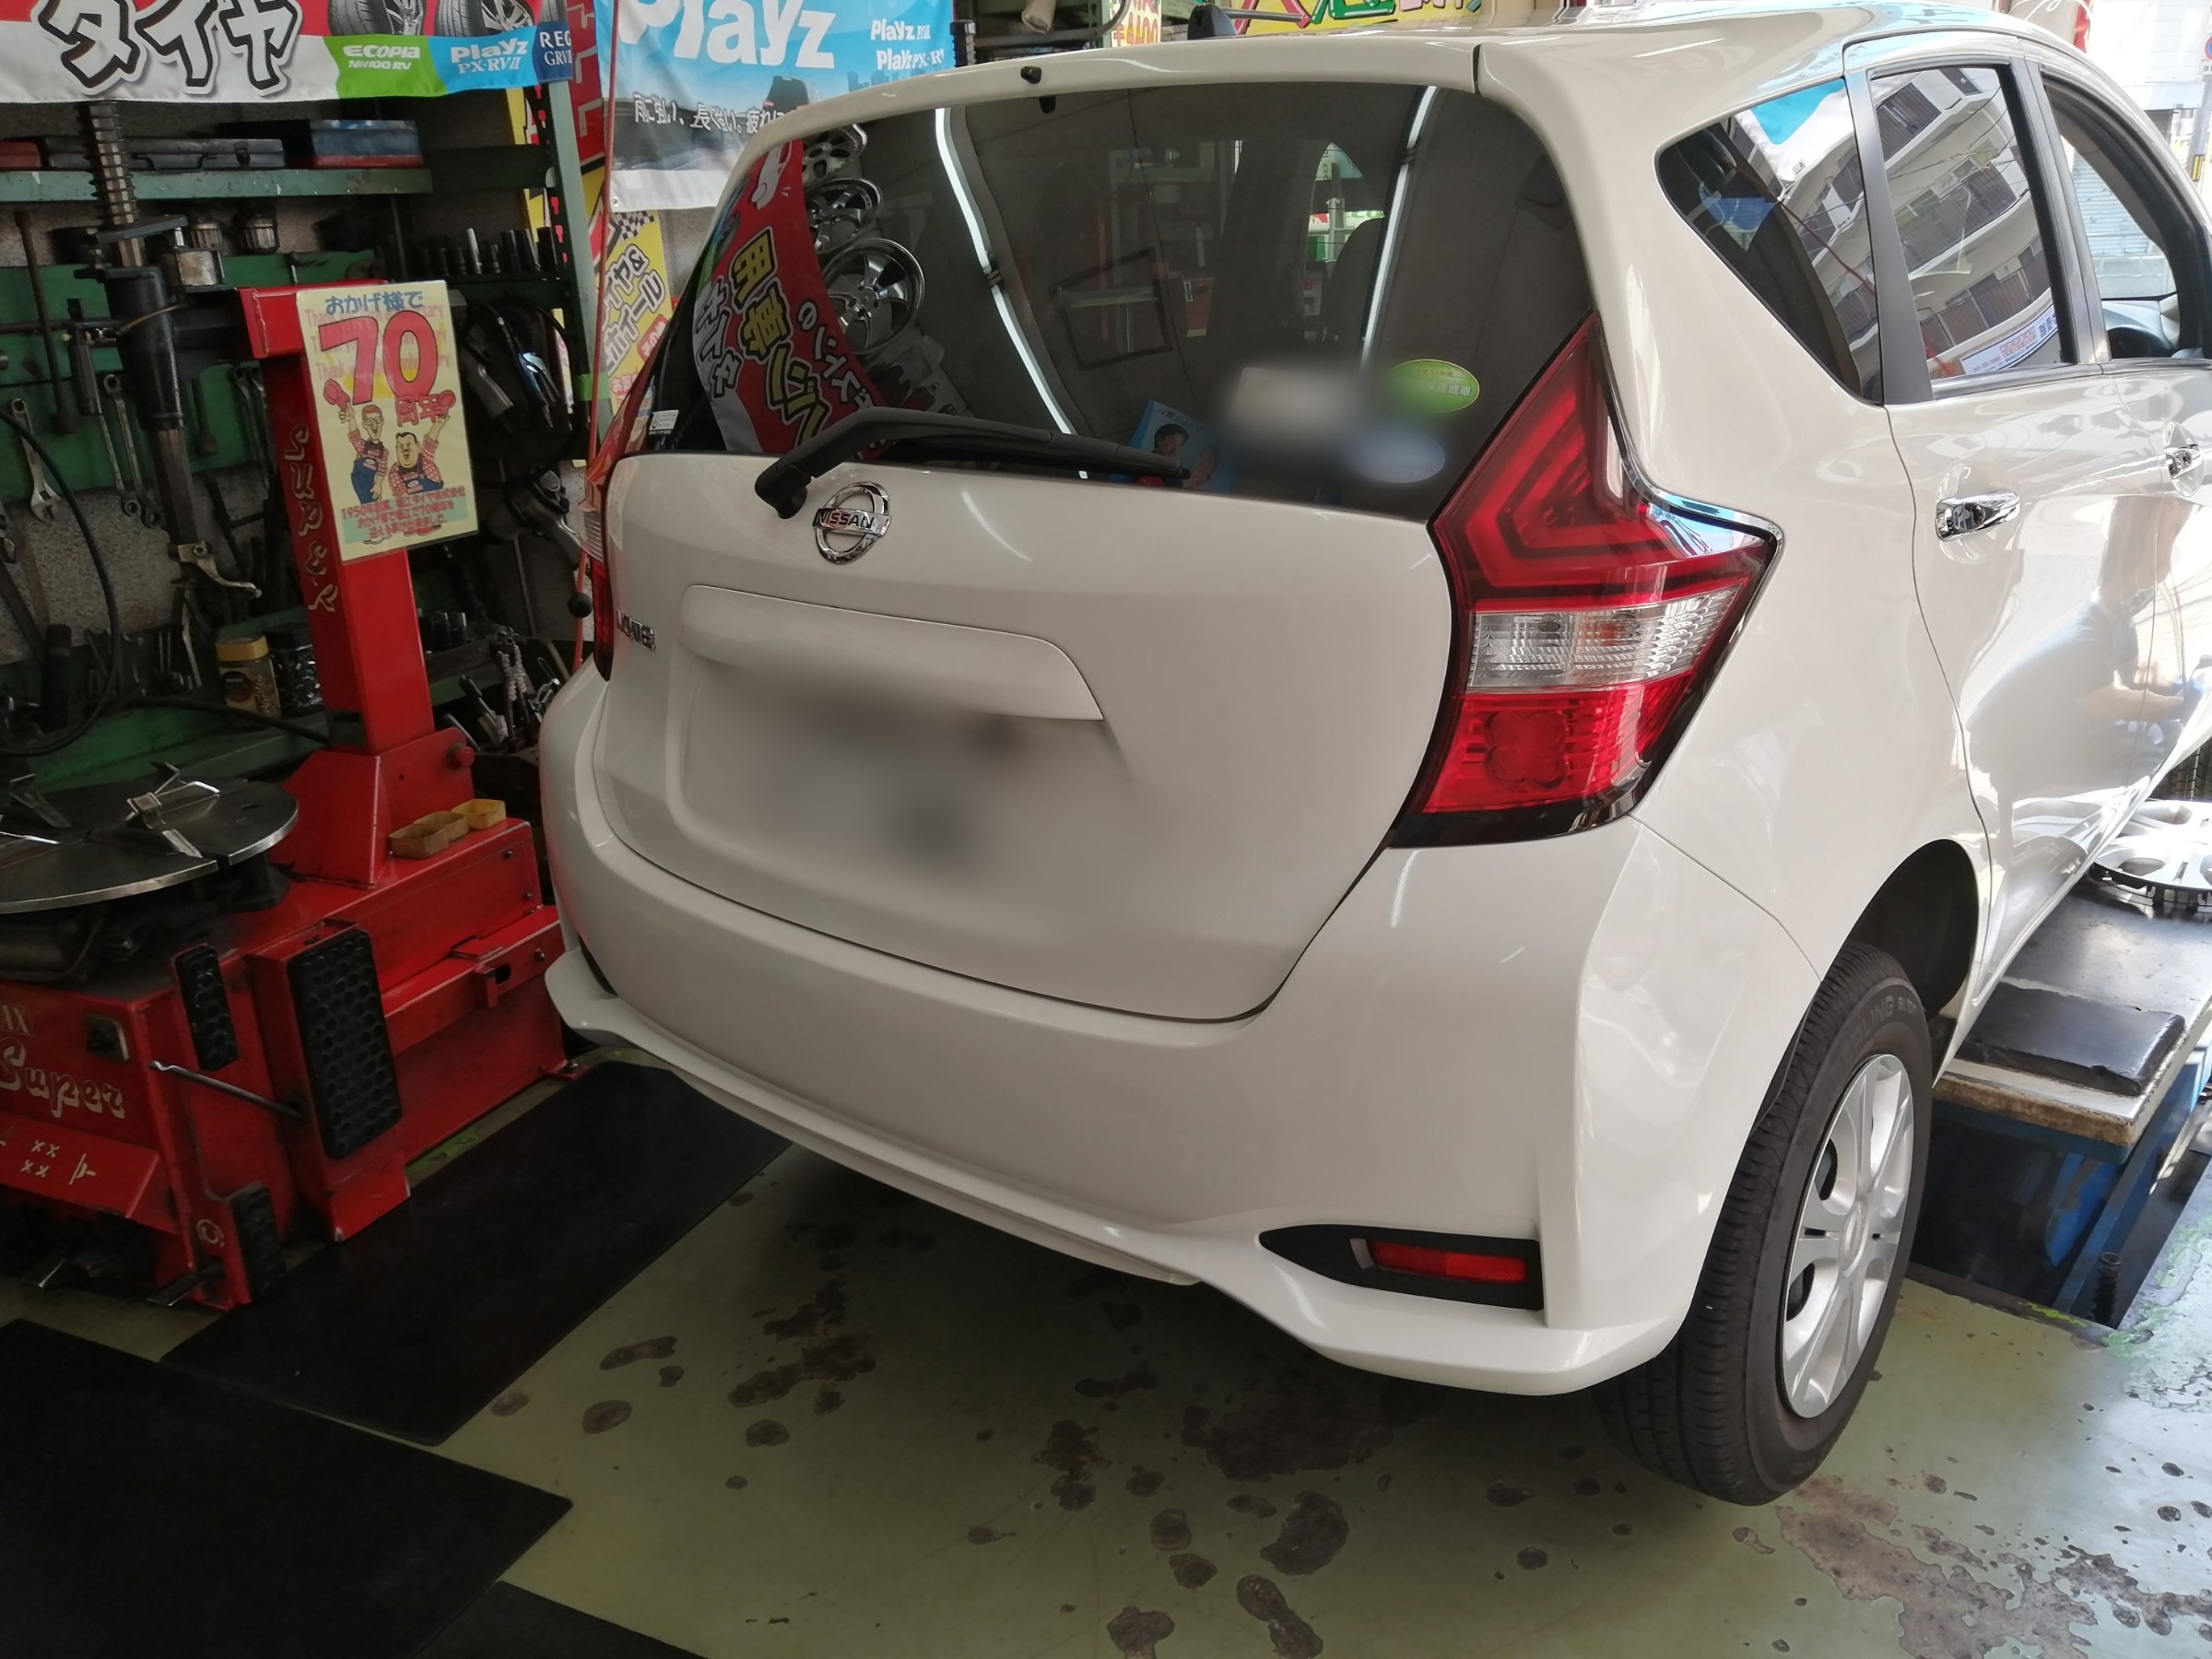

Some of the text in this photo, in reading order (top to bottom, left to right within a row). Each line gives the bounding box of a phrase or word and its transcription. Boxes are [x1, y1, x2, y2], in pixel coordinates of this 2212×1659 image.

[35, 0, 299, 90] タイヤ
[450, 37, 529, 64] Playz
[392, 61, 413, 71] RV
[324, 290, 425, 316] おかげ様で
[318, 310, 439, 406] 70
[814, 508, 875, 530] NISSAN
